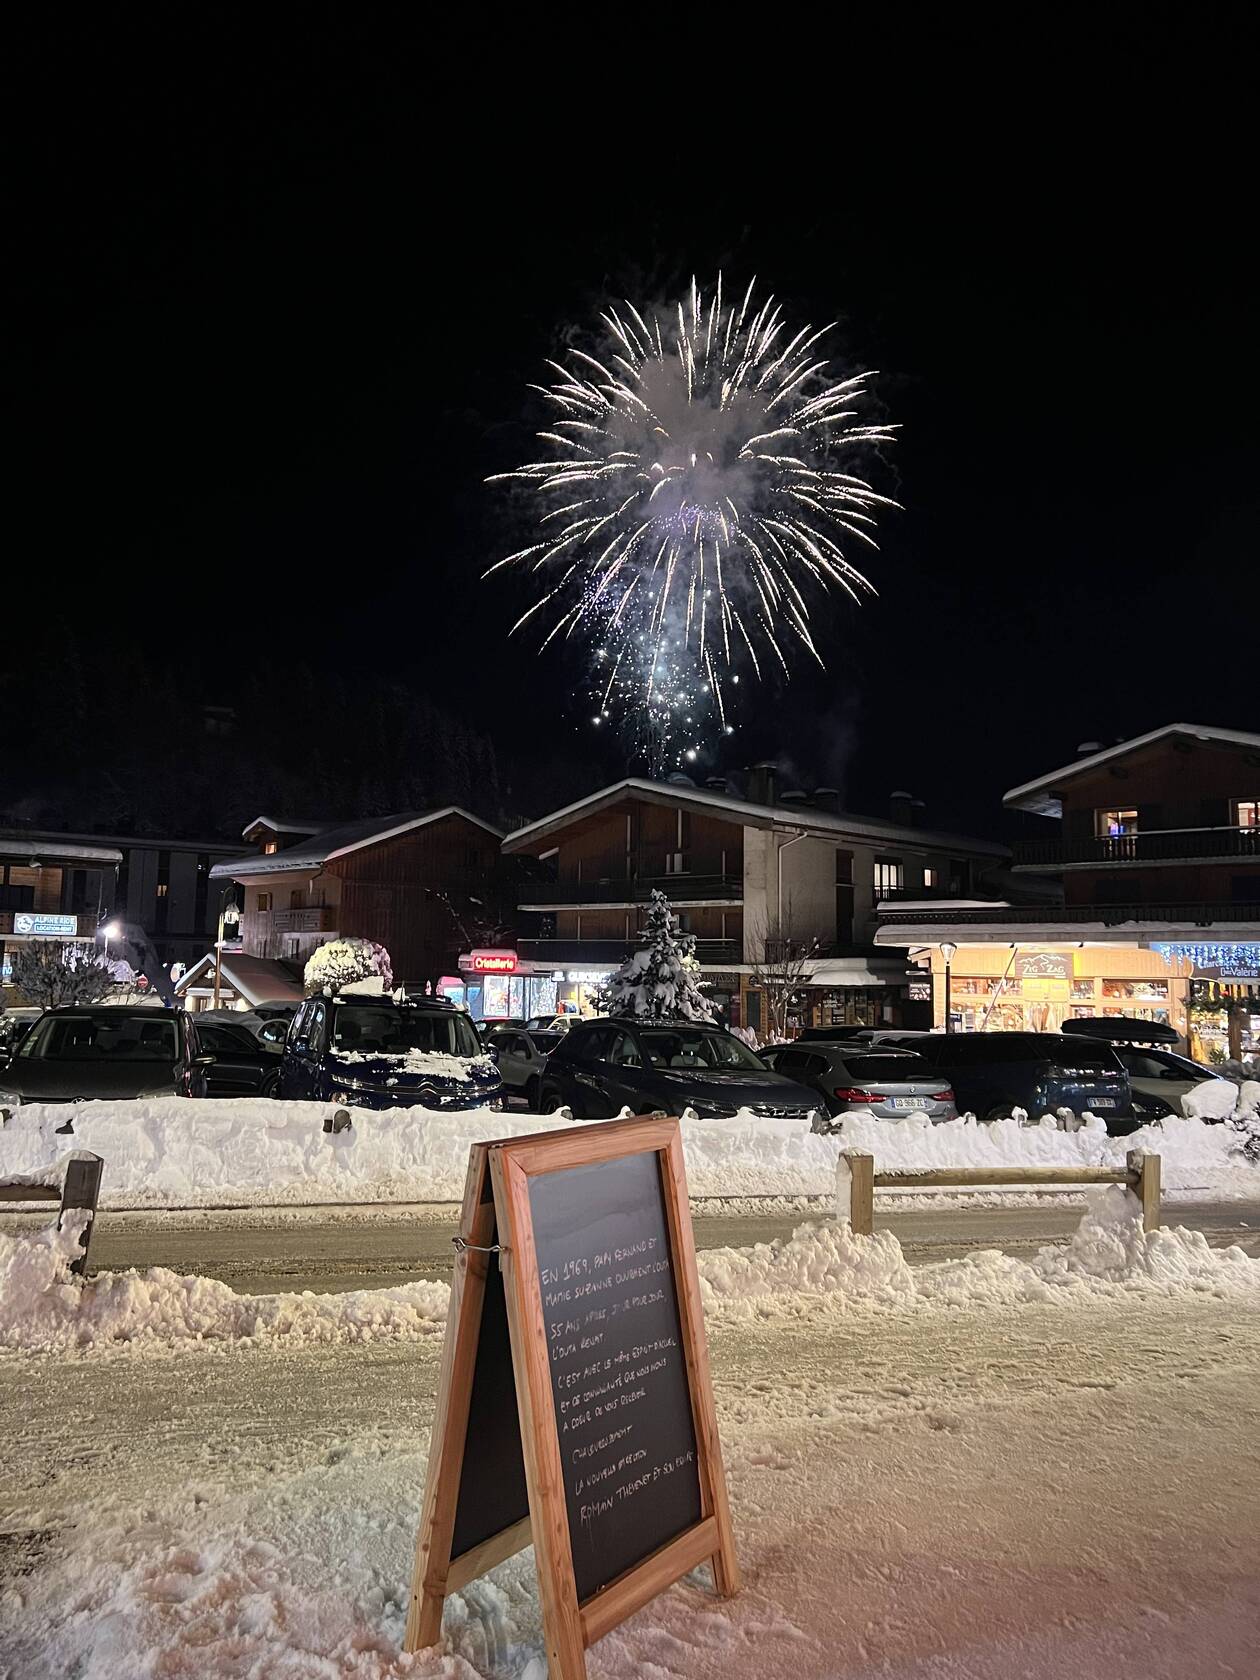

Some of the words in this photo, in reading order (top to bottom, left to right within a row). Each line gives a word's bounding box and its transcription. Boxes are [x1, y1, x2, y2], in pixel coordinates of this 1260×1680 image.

[541, 1267, 559, 1286] EN
[648, 1237, 657, 1249] ET
[574, 1276, 613, 1299] SUZANNE
[551, 1323, 563, 1340] 55
[558, 1372, 581, 1389] C'EST
[584, 1361, 601, 1379] AVEC
[561, 1400, 570, 1413] ET
[624, 1370, 636, 1383] QUE
[653, 1466, 661, 1481] ET
[575, 1479, 585, 1496] LA
